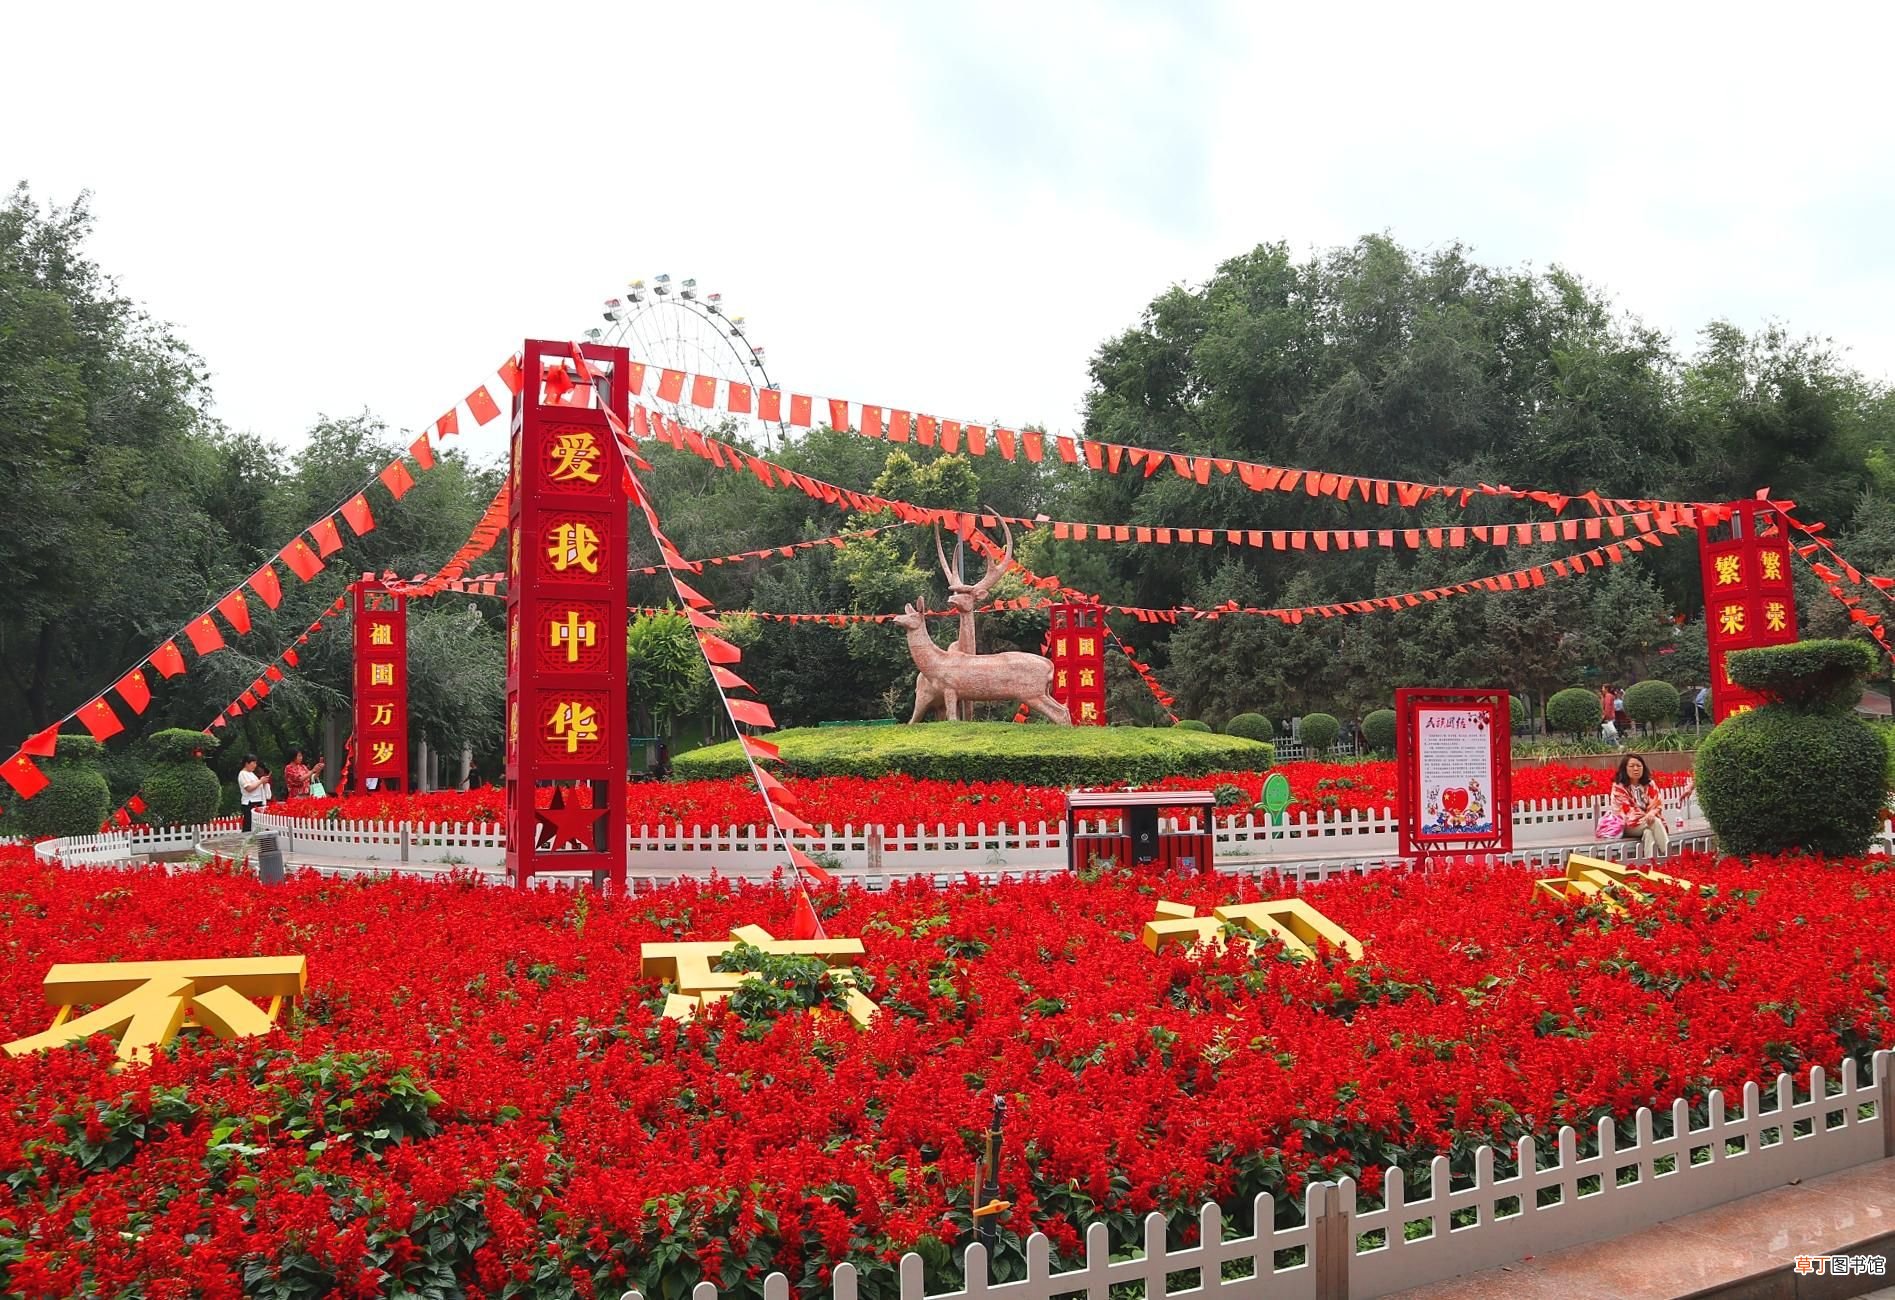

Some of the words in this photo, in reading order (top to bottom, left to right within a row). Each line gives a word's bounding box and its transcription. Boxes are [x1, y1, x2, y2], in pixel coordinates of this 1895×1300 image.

[547, 432, 602, 753] 爱我中华
[1760, 551, 1787, 632] 繁荣
[369, 623, 395, 766] 祖国万岁
